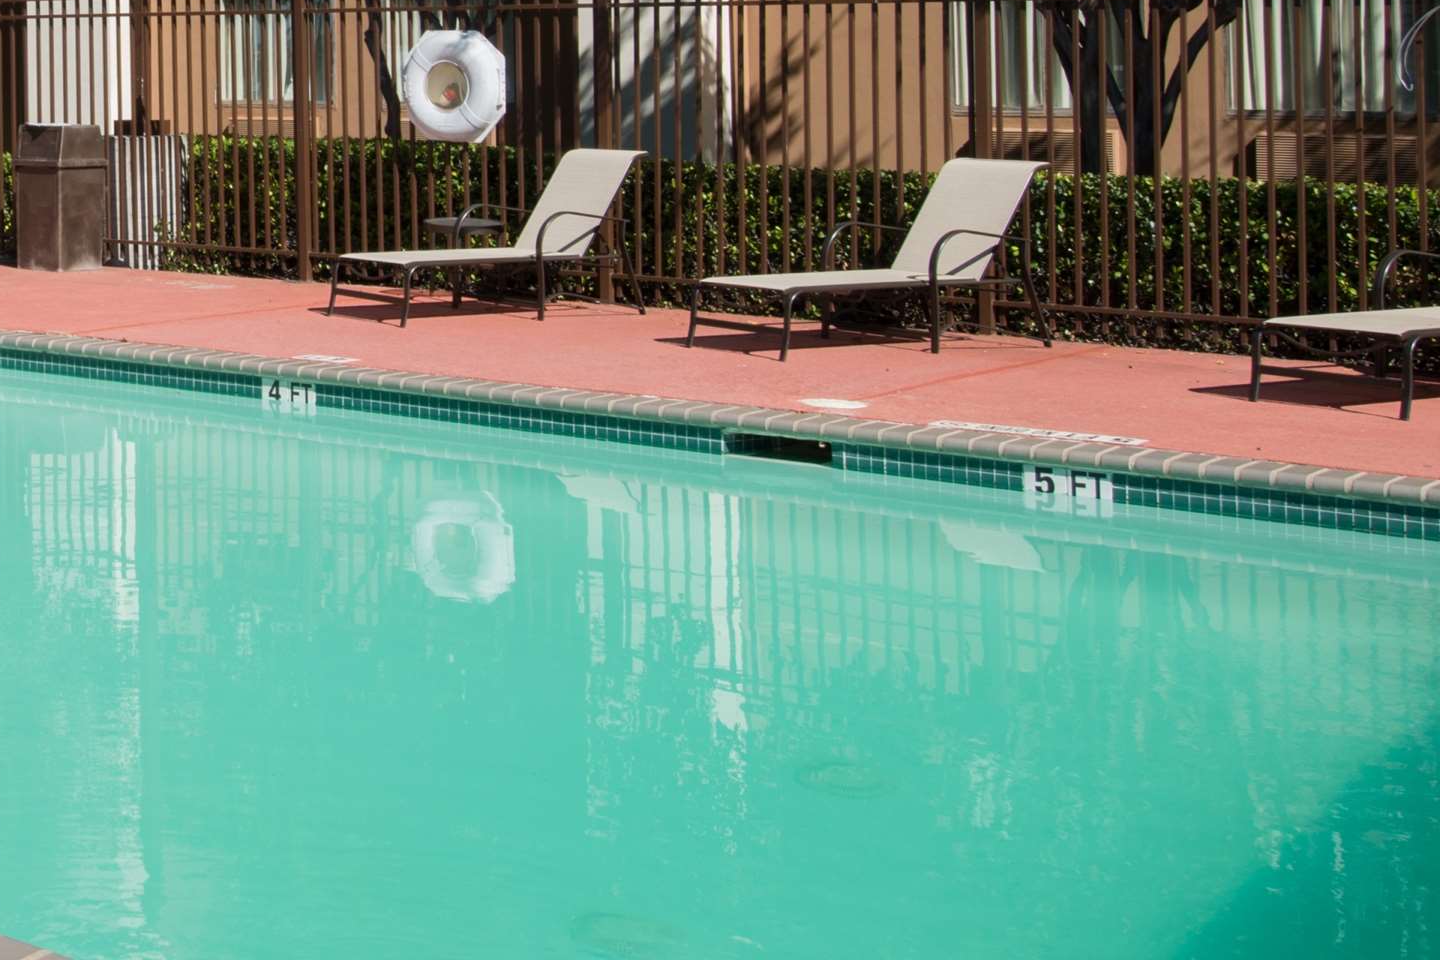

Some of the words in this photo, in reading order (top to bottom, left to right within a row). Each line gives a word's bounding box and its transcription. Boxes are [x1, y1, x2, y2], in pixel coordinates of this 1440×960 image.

[268, 379, 282, 400] 4
[290, 382, 313, 404] FT
[1034, 466, 1056, 494] 5
[1070, 470, 1107, 499] FT
